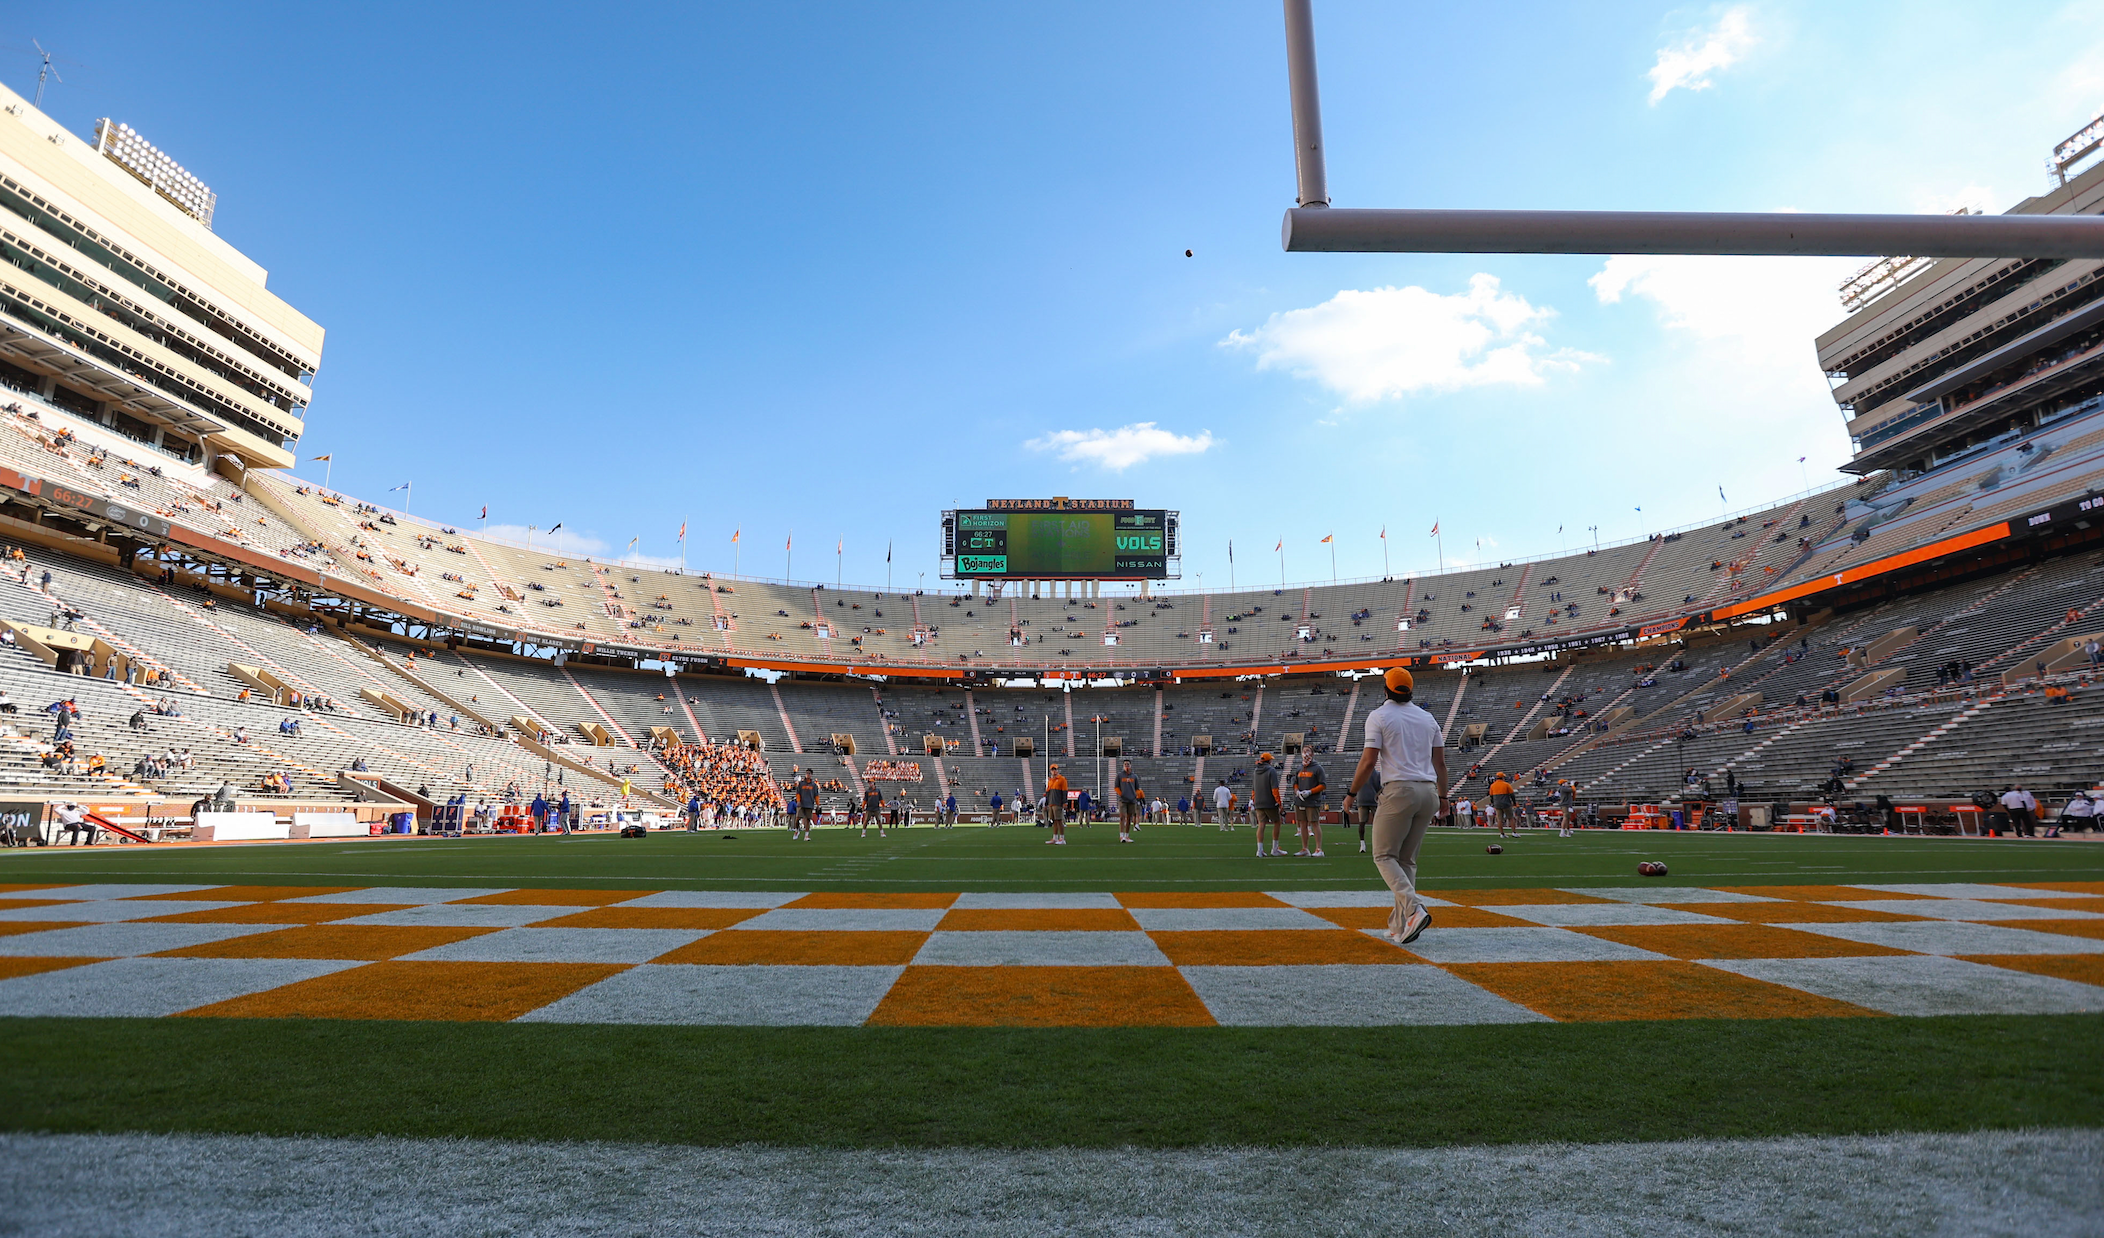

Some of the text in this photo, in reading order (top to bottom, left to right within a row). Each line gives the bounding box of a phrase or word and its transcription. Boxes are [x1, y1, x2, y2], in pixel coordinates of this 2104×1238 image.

[18, 472, 38, 493] T
[53, 487, 94, 508] 66:27
[991, 499, 1050, 508] NEYLAND
[1071, 500, 1130, 508] STADIUM
[139, 516, 149, 527] 0
[1031, 520, 1091, 529] FIRST AID
[162, 527, 168, 535] 3
[1031, 529, 1091, 539] STATIONS
[984, 538, 994, 548] T
[1116, 536, 1161, 550] VOLS
[961, 557, 1005, 571] Bojangles
[319, 575, 327, 586] T
[1834, 574, 1843, 585] T
[1568, 640, 1582, 648] 1951
[1643, 621, 1680, 635] CHAMPIONS
[1438, 653, 1472, 662] NATIONAL
[847, 666, 854, 675] T
[1070, 671, 1079, 679] T
[435, 807, 442, 815] F
[448, 807, 456, 815] F
